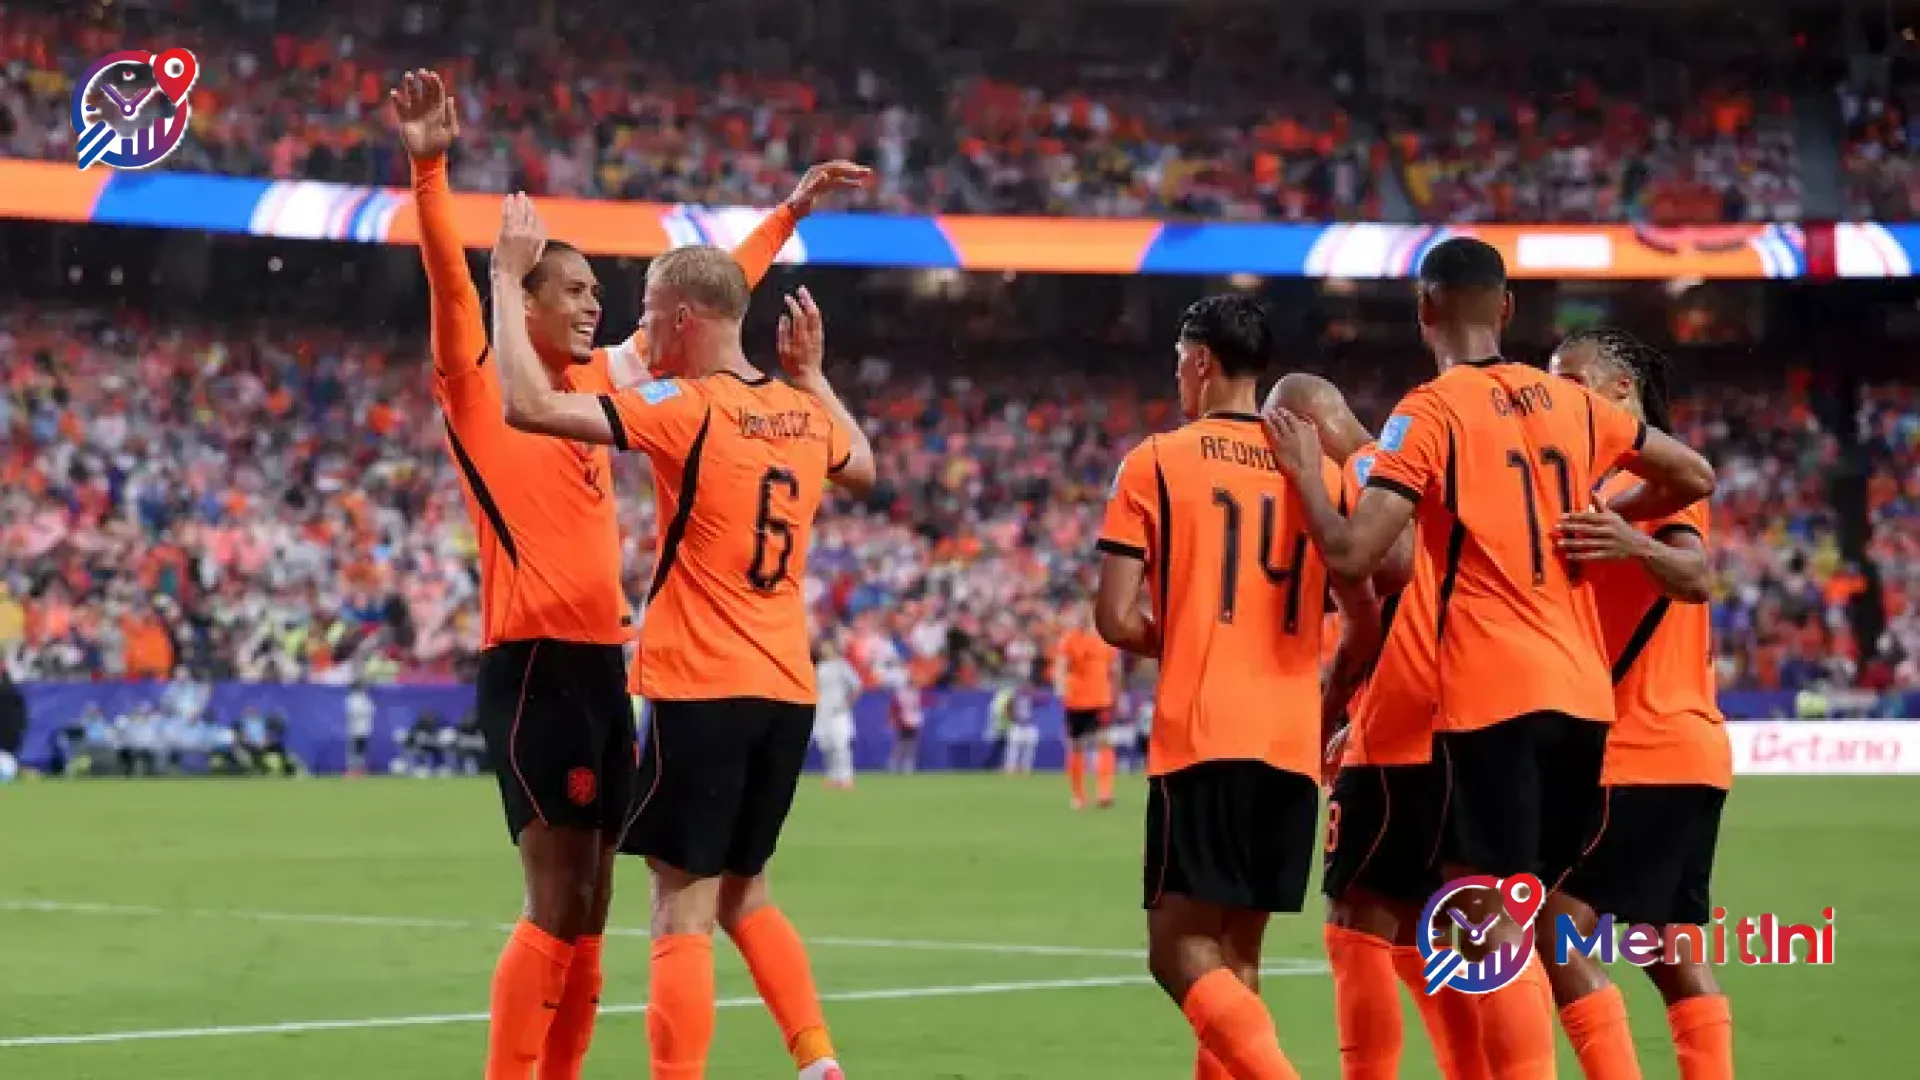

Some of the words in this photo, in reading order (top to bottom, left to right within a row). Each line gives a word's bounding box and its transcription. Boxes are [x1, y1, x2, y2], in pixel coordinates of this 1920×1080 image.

[747, 466, 799, 589] 6
[1213, 486, 1308, 636] 14
[1506, 445, 1583, 588] 11
